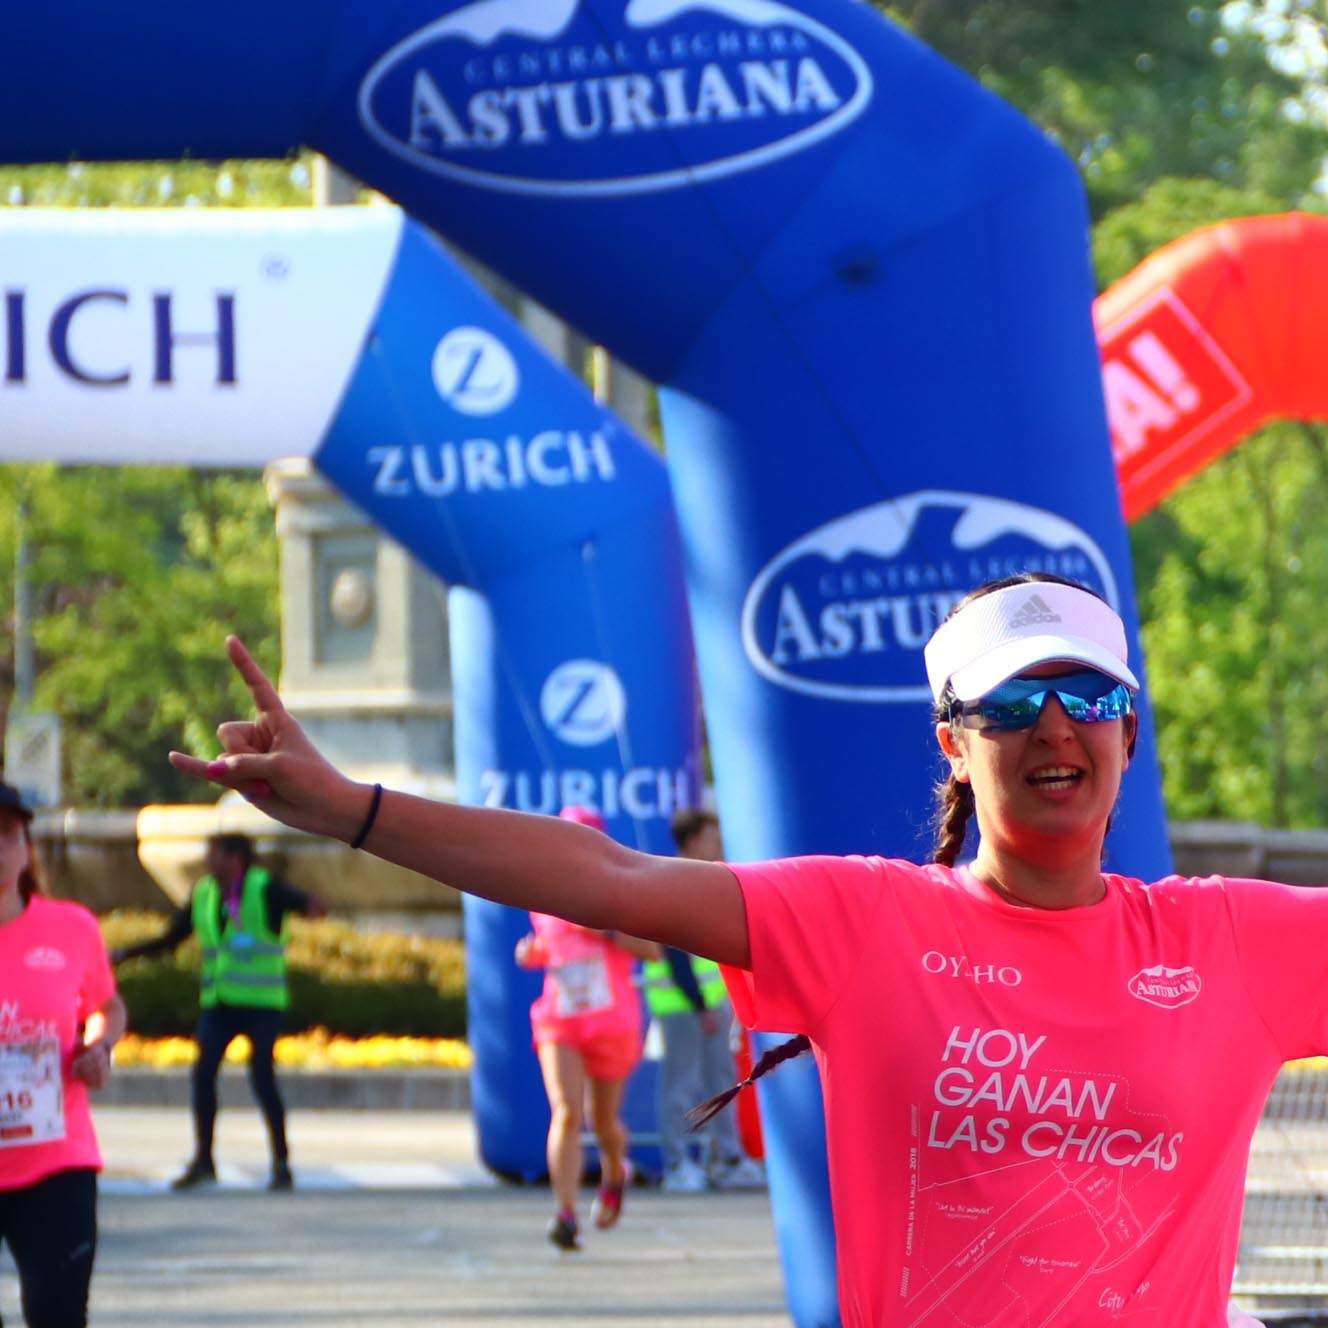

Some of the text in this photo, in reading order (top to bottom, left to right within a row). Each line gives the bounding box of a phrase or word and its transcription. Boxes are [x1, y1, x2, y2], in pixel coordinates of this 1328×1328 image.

[464, 41, 632, 83] CENTRAL
[410, 57, 841, 150] ASTURIANA
[367, 430, 616, 496] ZURICH
[480, 767, 689, 820] ZURICH
[922, 951, 1022, 986] OYHO
[942, 1026, 1047, 1068] HOY
[934, 1068, 1116, 1120] GANAN
[909, 1147, 918, 1170] 2018
[928, 1112, 1184, 1172] LAS CHICAS
